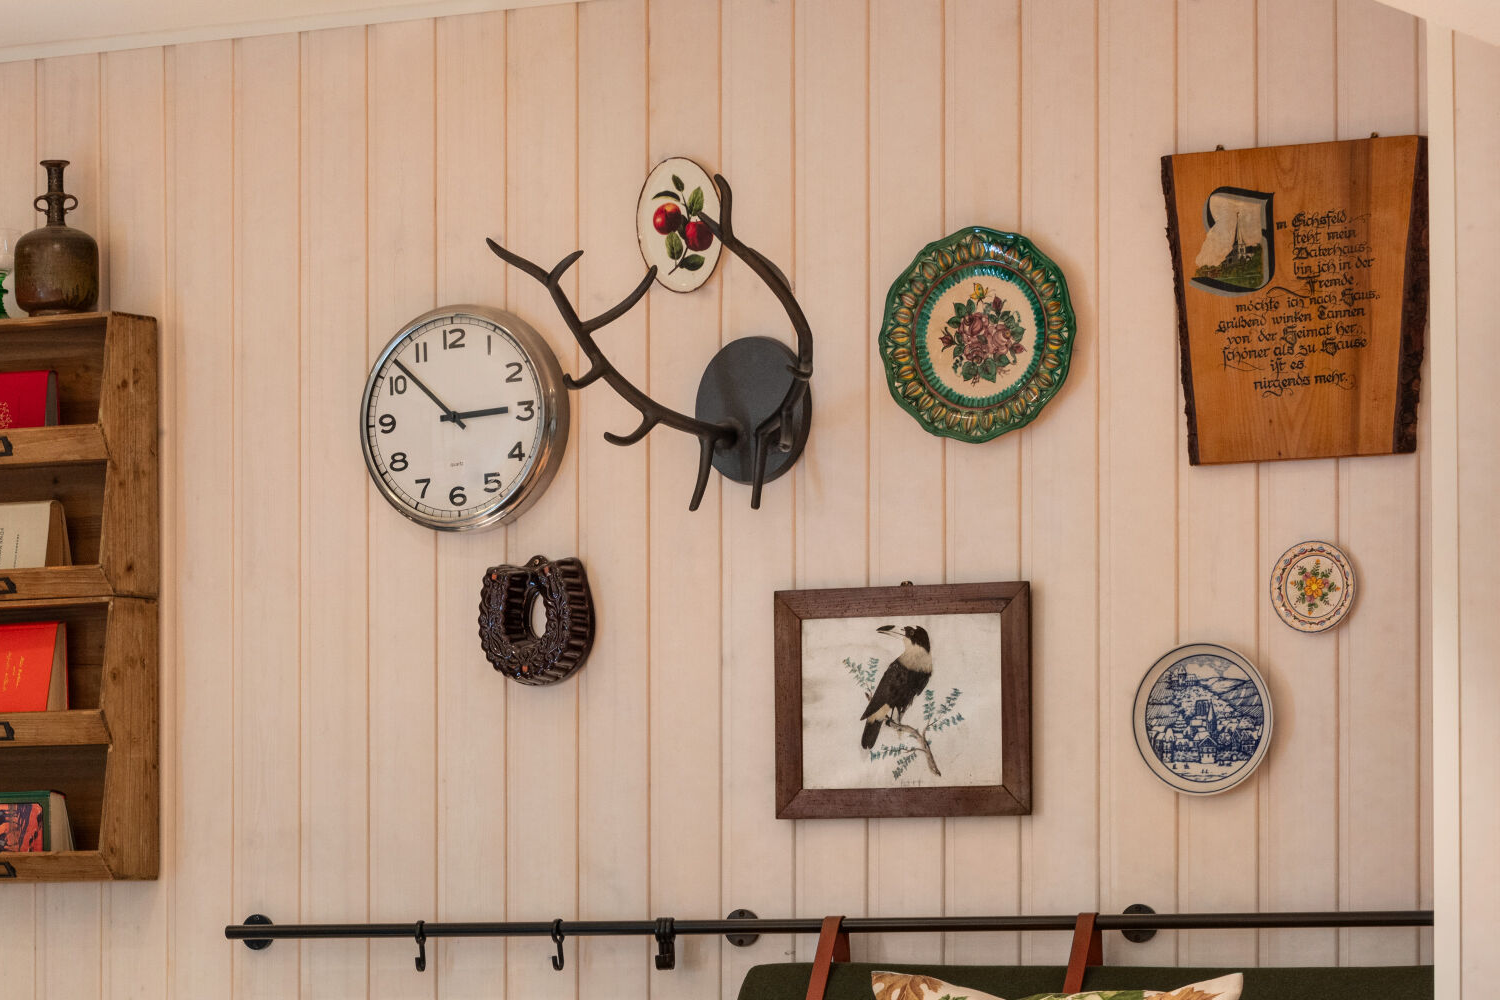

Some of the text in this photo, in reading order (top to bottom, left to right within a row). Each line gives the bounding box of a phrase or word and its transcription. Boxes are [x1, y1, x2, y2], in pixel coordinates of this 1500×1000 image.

[1327, 228, 1357, 241] mein
[1293, 261, 1313, 276] bin
[1338, 259, 1352, 271] in
[1355, 256, 1375, 270] der
[1287, 297, 1305, 310] ich
[1309, 292, 1337, 307] nach
[1271, 310, 1312, 325] winken
[1317, 306, 1366, 320] Tannen
[442, 328, 466, 350] 12
[487, 335, 492, 356] 1
[1226, 334, 1251, 348] von
[1257, 329, 1277, 343] der
[1280, 324, 1333, 345] Heimat
[415, 341, 428, 363] 11
[1273, 343, 1295, 358] als
[1298, 344, 1317, 357] zu
[1320, 337, 1368, 357] Hause
[505, 362, 523, 383] 2
[389, 374, 407, 396] 10
[1253, 374, 1311, 395] nirgends
[515, 400, 535, 421] 3
[378, 413, 397, 434] 9
[389, 452, 409, 472] 8
[507, 441, 526, 462] 4
[415, 478, 431, 499] 7
[484, 472, 502, 493] 5
[449, 486, 467, 507] 6
